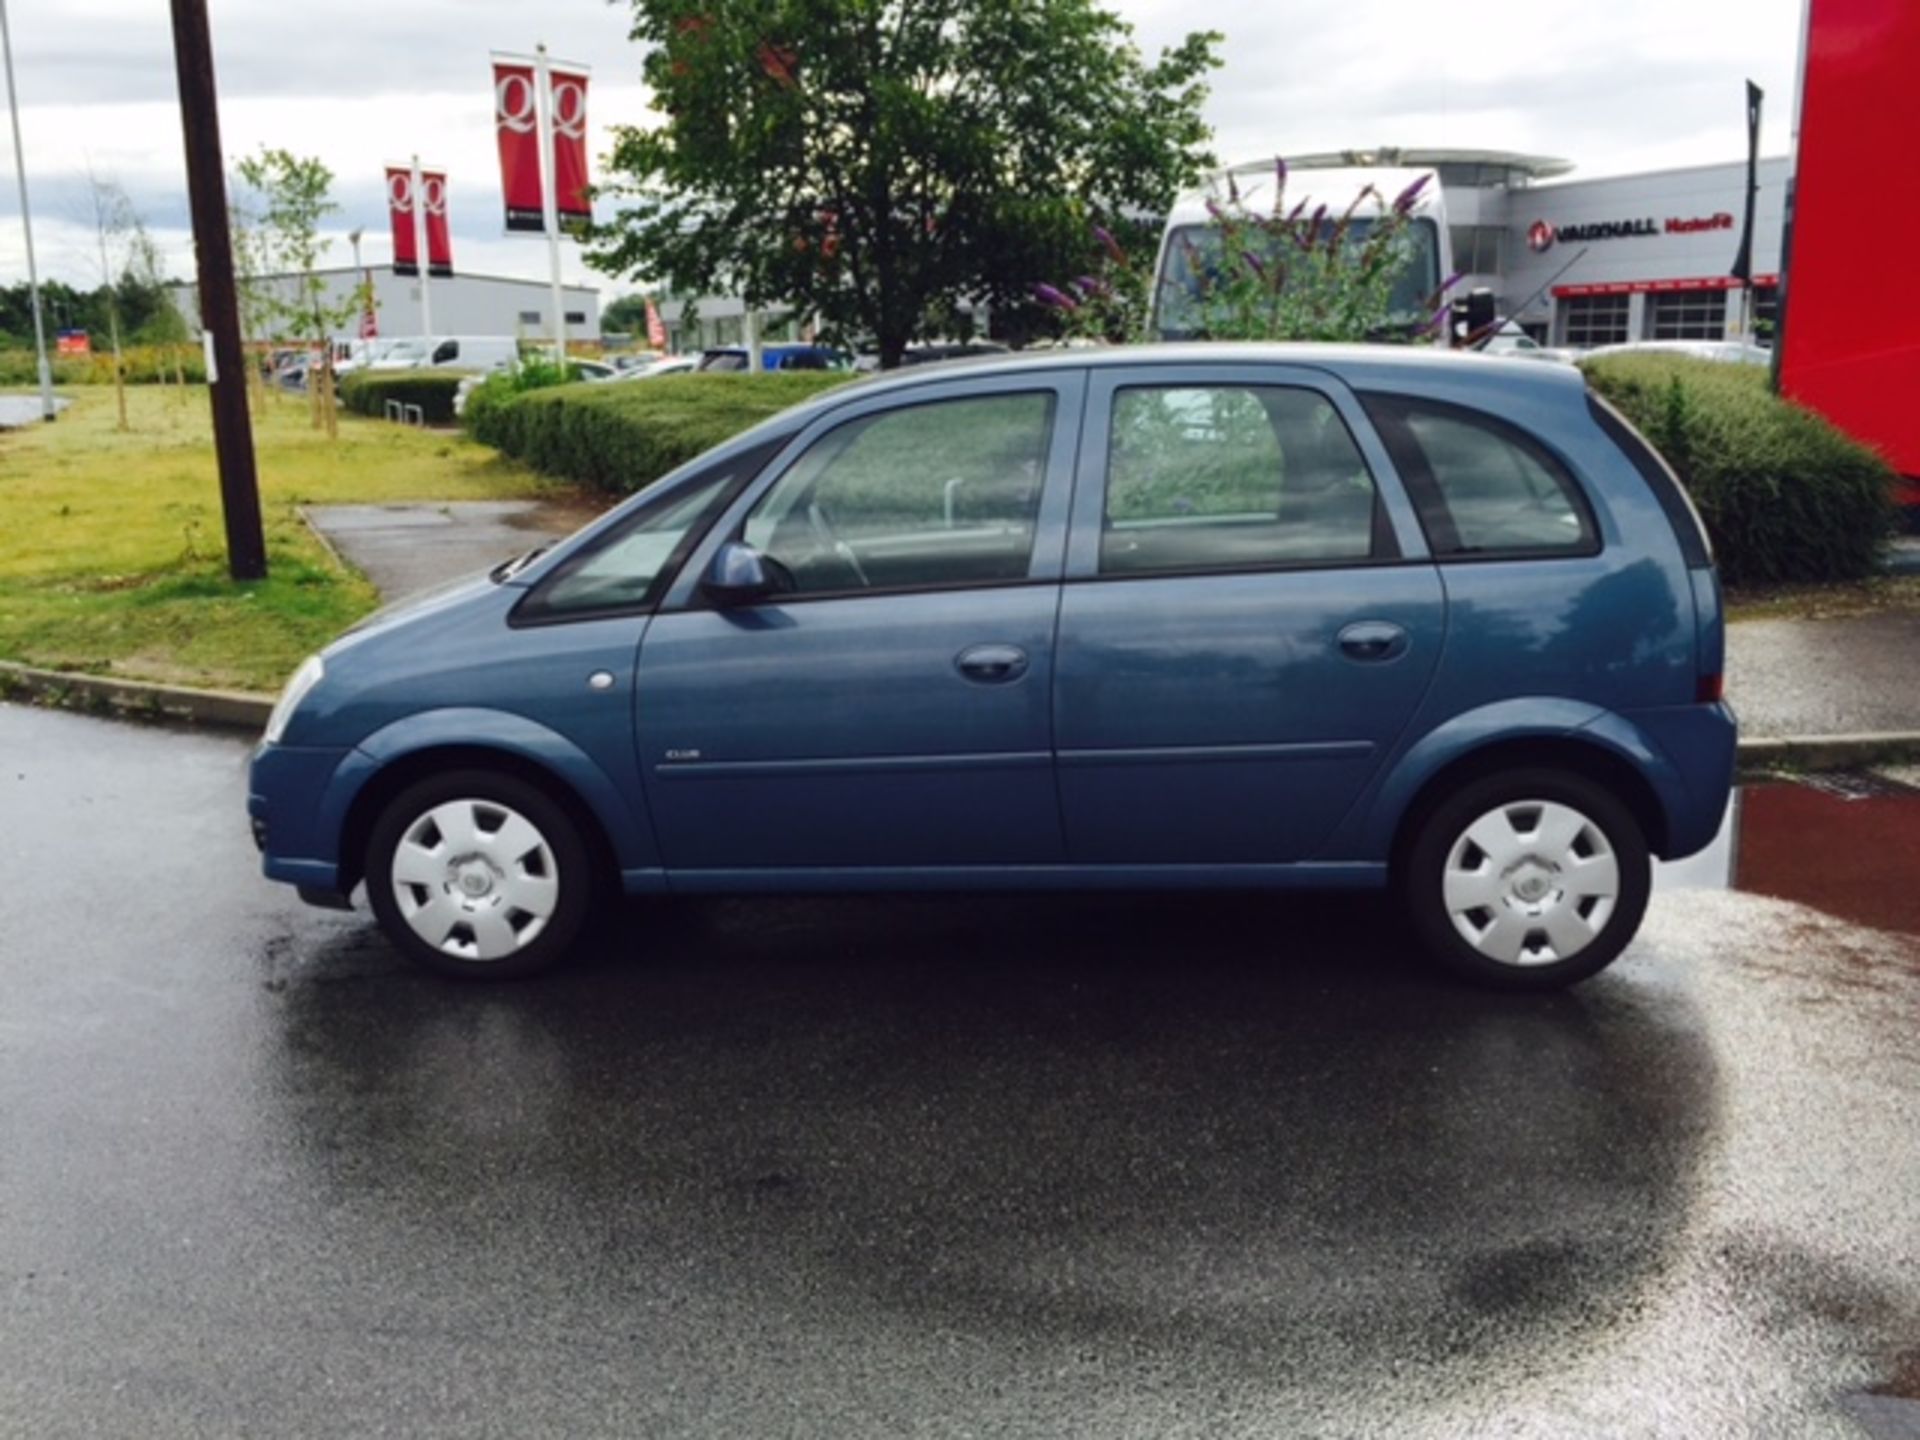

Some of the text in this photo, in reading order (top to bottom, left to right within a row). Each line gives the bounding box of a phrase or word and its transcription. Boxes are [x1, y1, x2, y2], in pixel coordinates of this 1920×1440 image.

[496, 74, 536, 133] Q
[551, 82, 587, 140] Q
[388, 174, 413, 213] Q
[423, 179, 447, 215] Q
[1555, 219, 1659, 242] VAUXHALL
